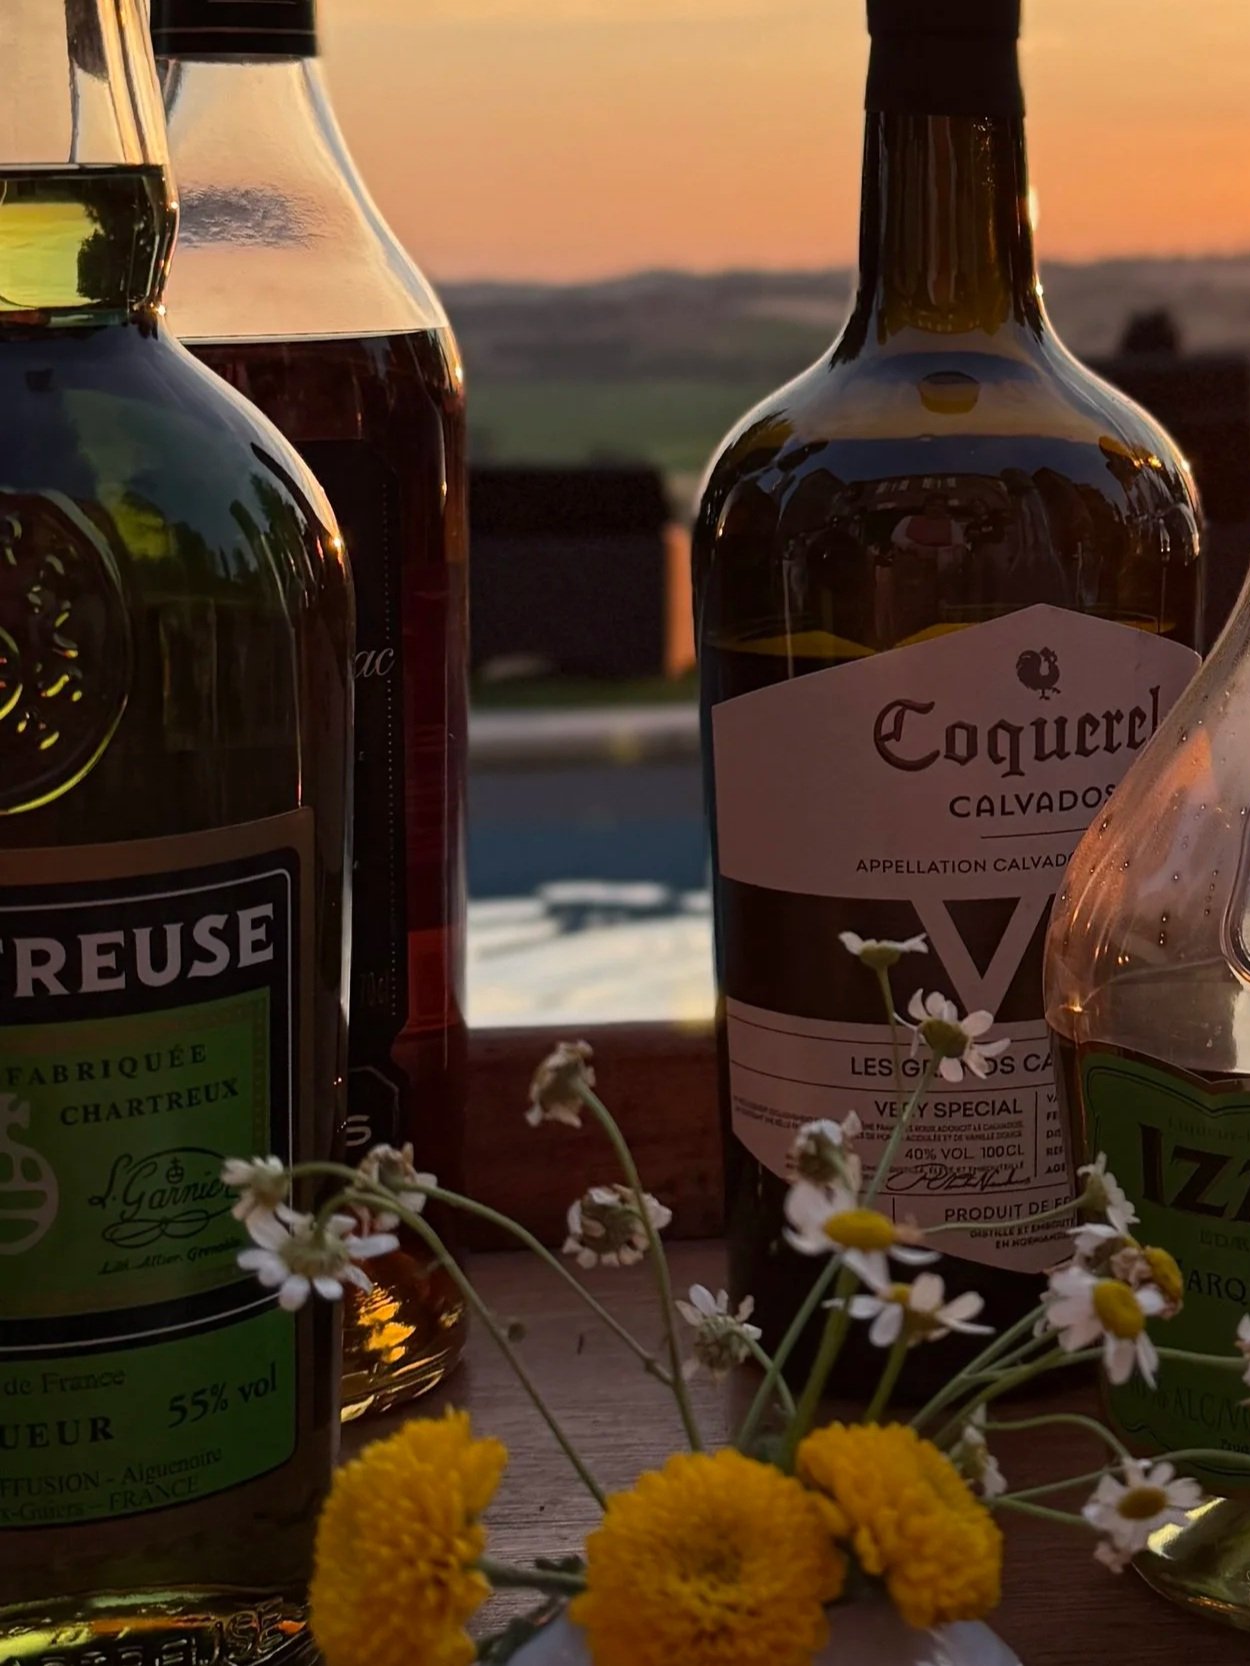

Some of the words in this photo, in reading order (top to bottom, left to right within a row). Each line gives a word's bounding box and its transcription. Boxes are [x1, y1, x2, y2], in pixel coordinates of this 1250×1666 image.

[873, 686, 1161, 778] Coquerel
[856, 857, 987, 877] APPELLATION
[0, 903, 274, 998] REUSE
[5, 1044, 208, 1087] FABRIQUÉE
[850, 1055, 894, 1078] LES
[60, 1078, 239, 1127] CHARTREUX
[932, 1098, 1023, 1119] SPECIAL
[904, 1147, 937, 1161] 40%
[945, 1203, 1023, 1222] PRODUIT
[1028, 1201, 1049, 1216] DE
[3, 1375, 34, 1397] de
[41, 1368, 127, 1395] France
[167, 1381, 230, 1429] 55%
[237, 1360, 279, 1404] vol
[108, 1475, 199, 1511] FRANCE
